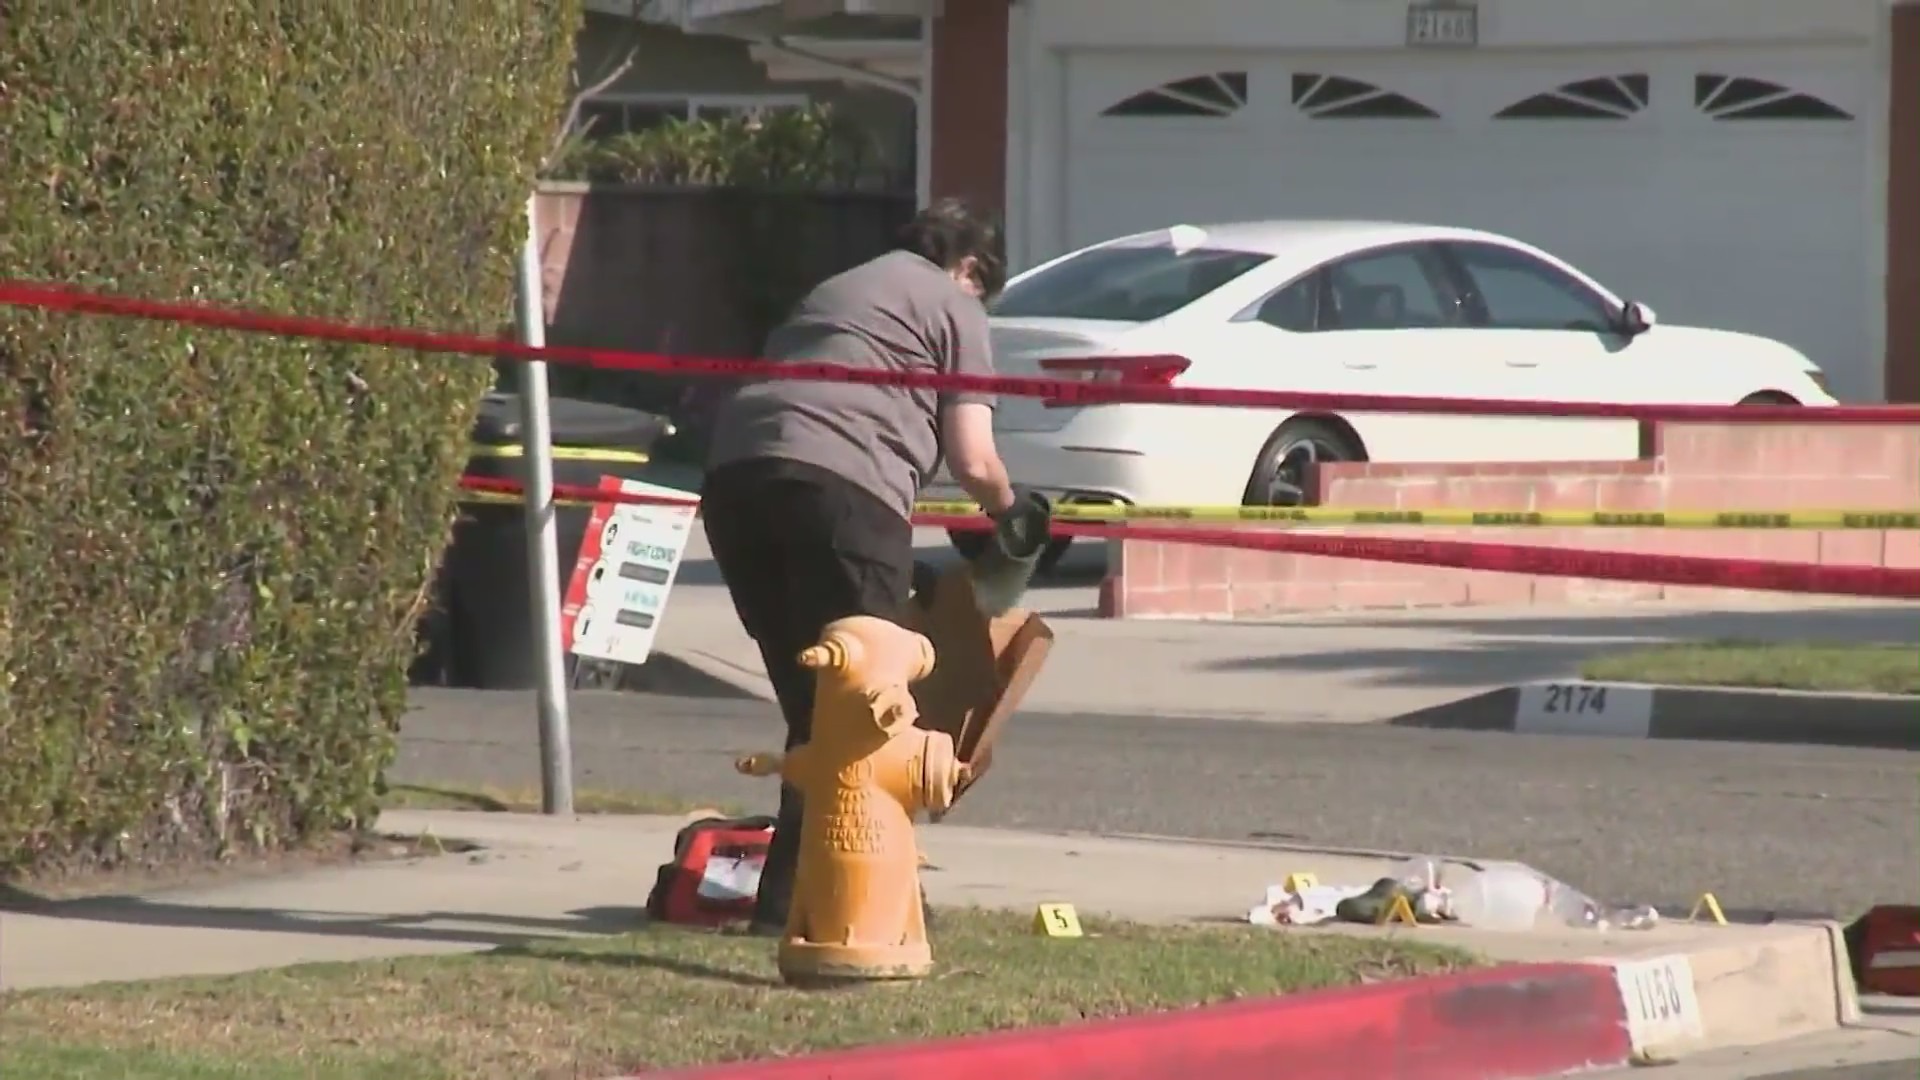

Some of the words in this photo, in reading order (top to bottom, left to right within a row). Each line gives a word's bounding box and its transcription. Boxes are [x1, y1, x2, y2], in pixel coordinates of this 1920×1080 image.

[627, 540, 651, 557] FIGHT
[651, 545, 677, 563] COVID
[1543, 684, 1608, 714] 2174
[1053, 908, 1068, 929] 5
[1635, 965, 1681, 1020] 1158
